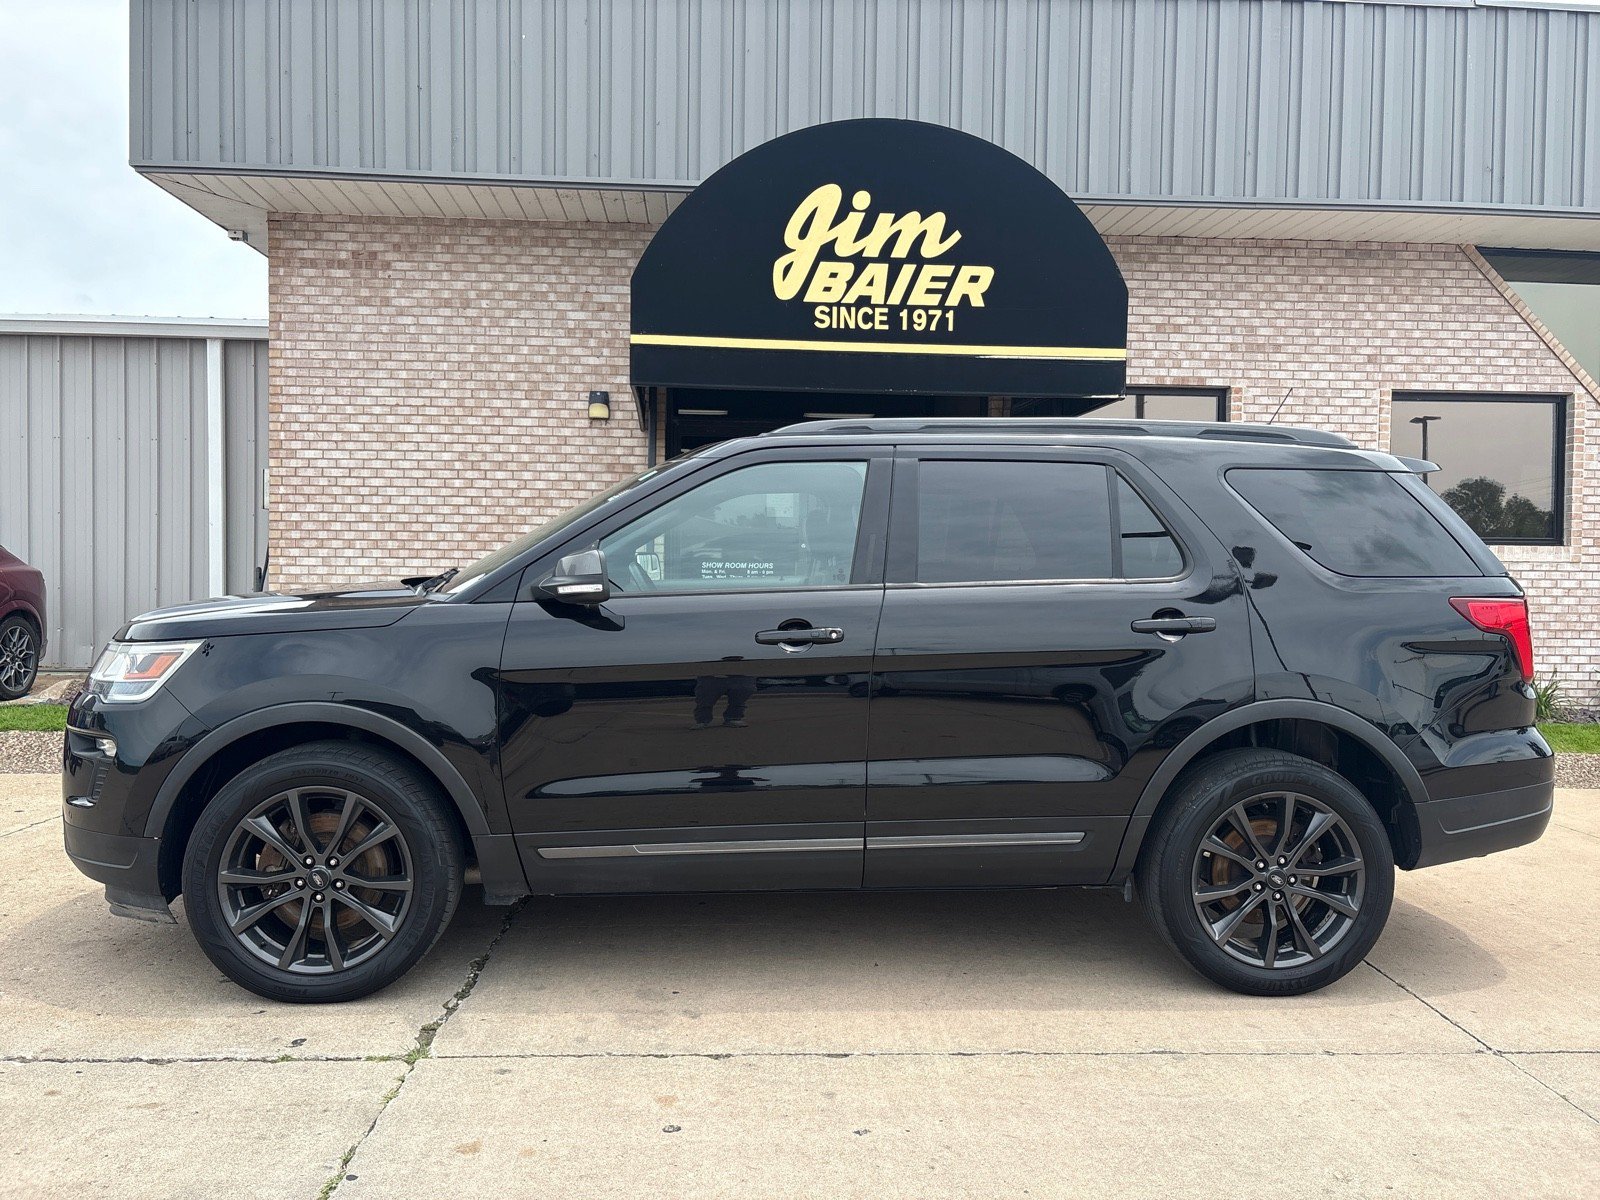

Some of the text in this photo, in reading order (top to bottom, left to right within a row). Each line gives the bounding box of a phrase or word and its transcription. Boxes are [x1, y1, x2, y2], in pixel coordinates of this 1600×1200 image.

[772, 183, 962, 301] Jim
[803, 261, 995, 308] BAIER
[813, 305, 954, 332] SINCE 1971
[748, 562, 774, 570] HOURS
